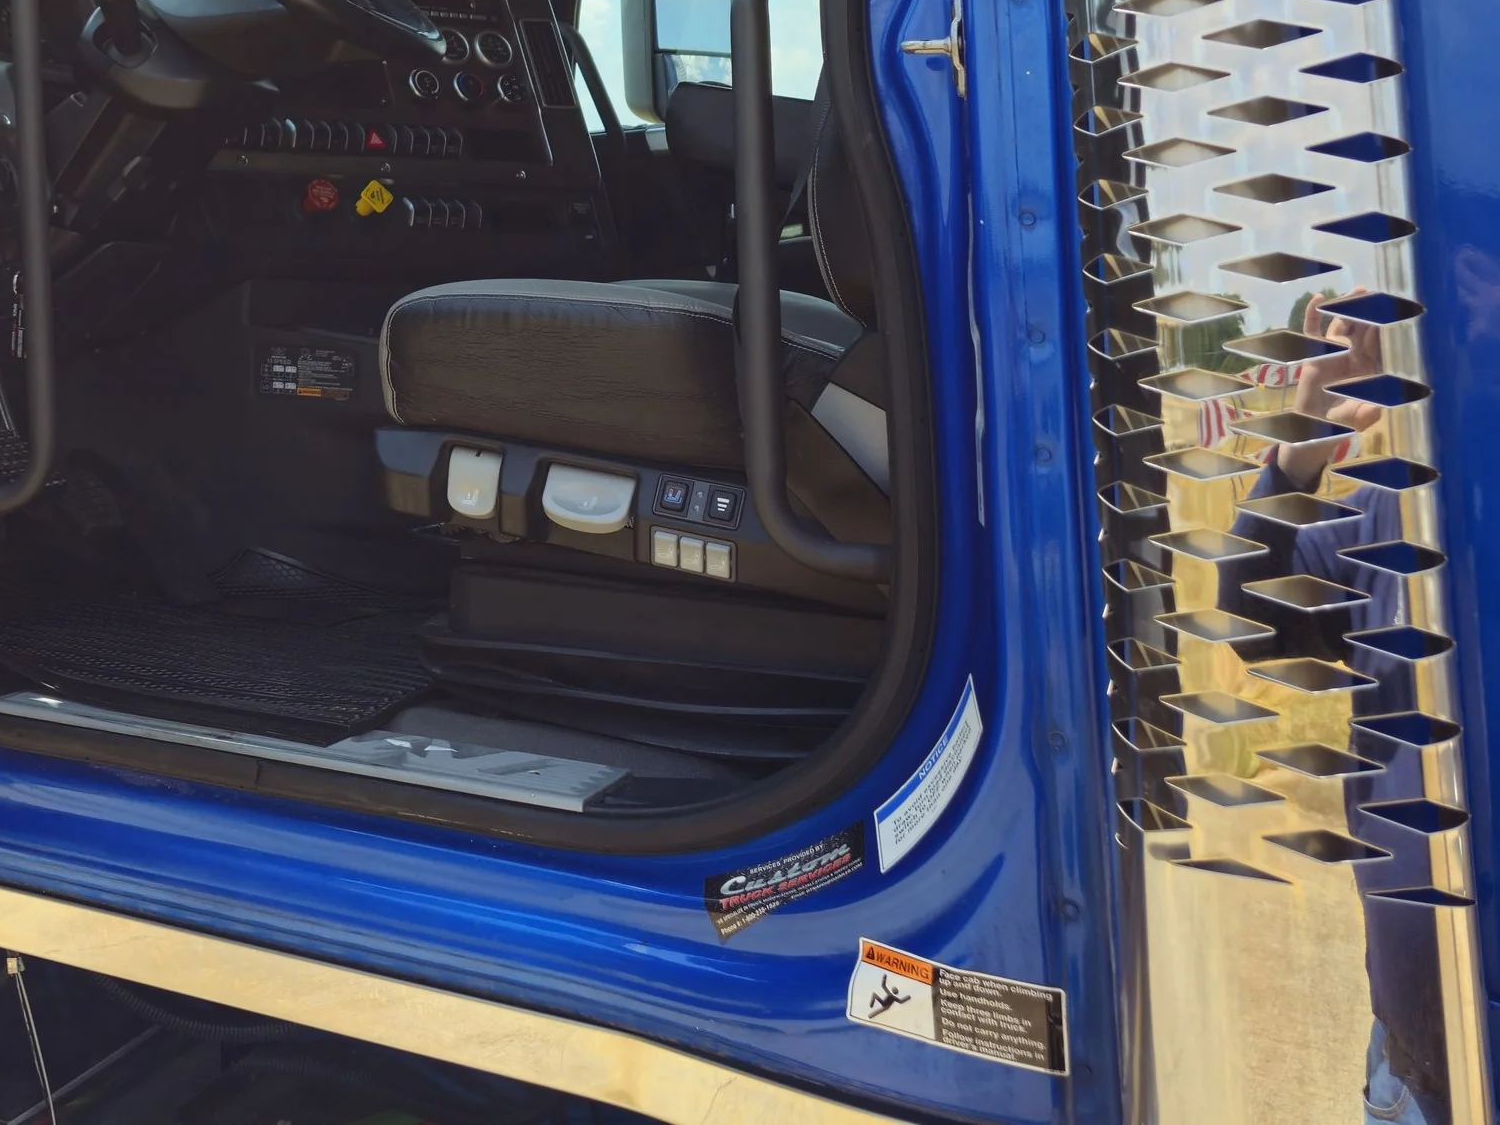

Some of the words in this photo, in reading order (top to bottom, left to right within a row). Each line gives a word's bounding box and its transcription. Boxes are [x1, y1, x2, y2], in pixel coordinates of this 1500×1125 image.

[918, 735, 949, 780] NOTICE
[720, 843, 850, 895] Custom
[720, 887, 773, 910] TRUCK
[778, 853, 852, 891] SERVICES
[750, 861, 780, 874] SERVICES
[721, 923, 737, 935] Phone
[876, 951, 929, 979] WARNING
[939, 978, 951, 987] up
[953, 981, 970, 989] and
[973, 985, 1002, 997] down.
[940, 969, 960, 980] Face
[963, 976, 980, 984] cab
[982, 979, 1008, 991] when
[1010, 986, 1053, 1002] climbing
[940, 988, 958, 998] Use
[960, 993, 1012, 1011] handholds.
[940, 999, 964, 1011] Keep
[966, 1005, 991, 1017] three
[993, 1011, 1019, 1024] limbs
[1022, 1018, 1031, 1027] in
[940, 1007, 976, 1021] contact
[978, 1016, 997, 1026] with
[1000, 1020, 1028, 1033] truck.
[942, 1017, 954, 1027] Do
[957, 1023, 972, 1032] not
[975, 1027, 998, 1039] carry
[1001, 1033, 1046, 1050] anything.
[942, 1029, 974, 1043] Follow
[975, 1038, 1032, 1057] instructions
[1035, 1052, 1044, 1061] in
[943, 1037, 977, 1051] driver's
[980, 1046, 1017, 1061] manual.
